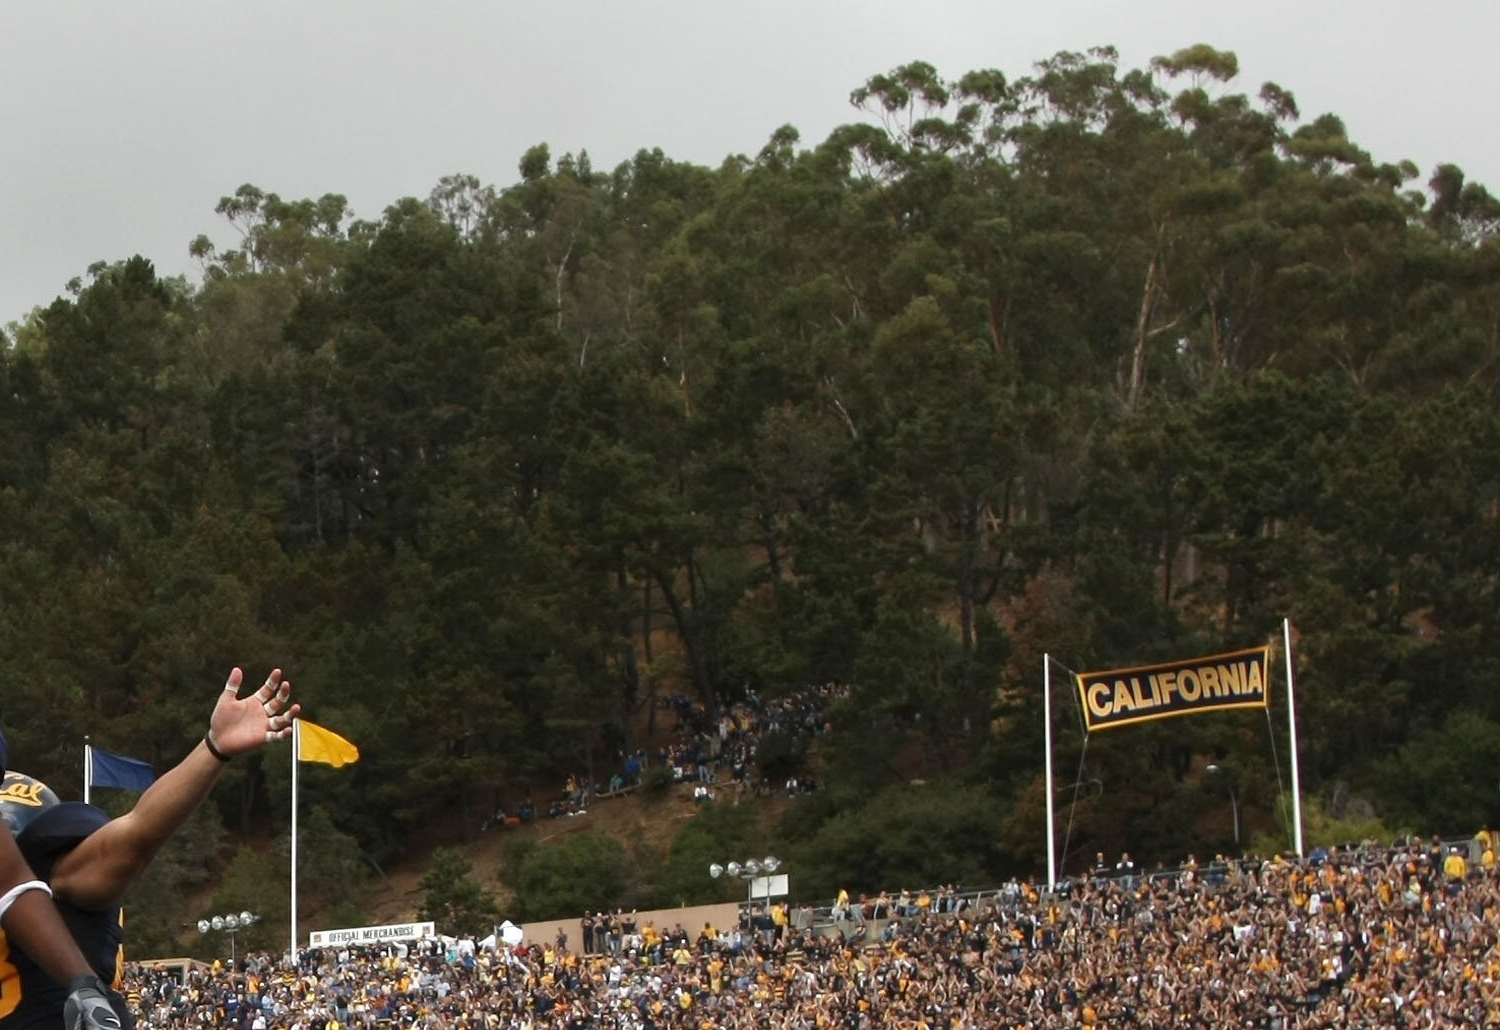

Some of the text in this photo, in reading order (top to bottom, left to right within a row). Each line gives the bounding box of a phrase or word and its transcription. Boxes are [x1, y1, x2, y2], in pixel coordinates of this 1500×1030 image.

[1087, 661, 1263, 717] CALIFORNIA
[328, 925, 415, 943] OFFICIAL MERCHANDISE
